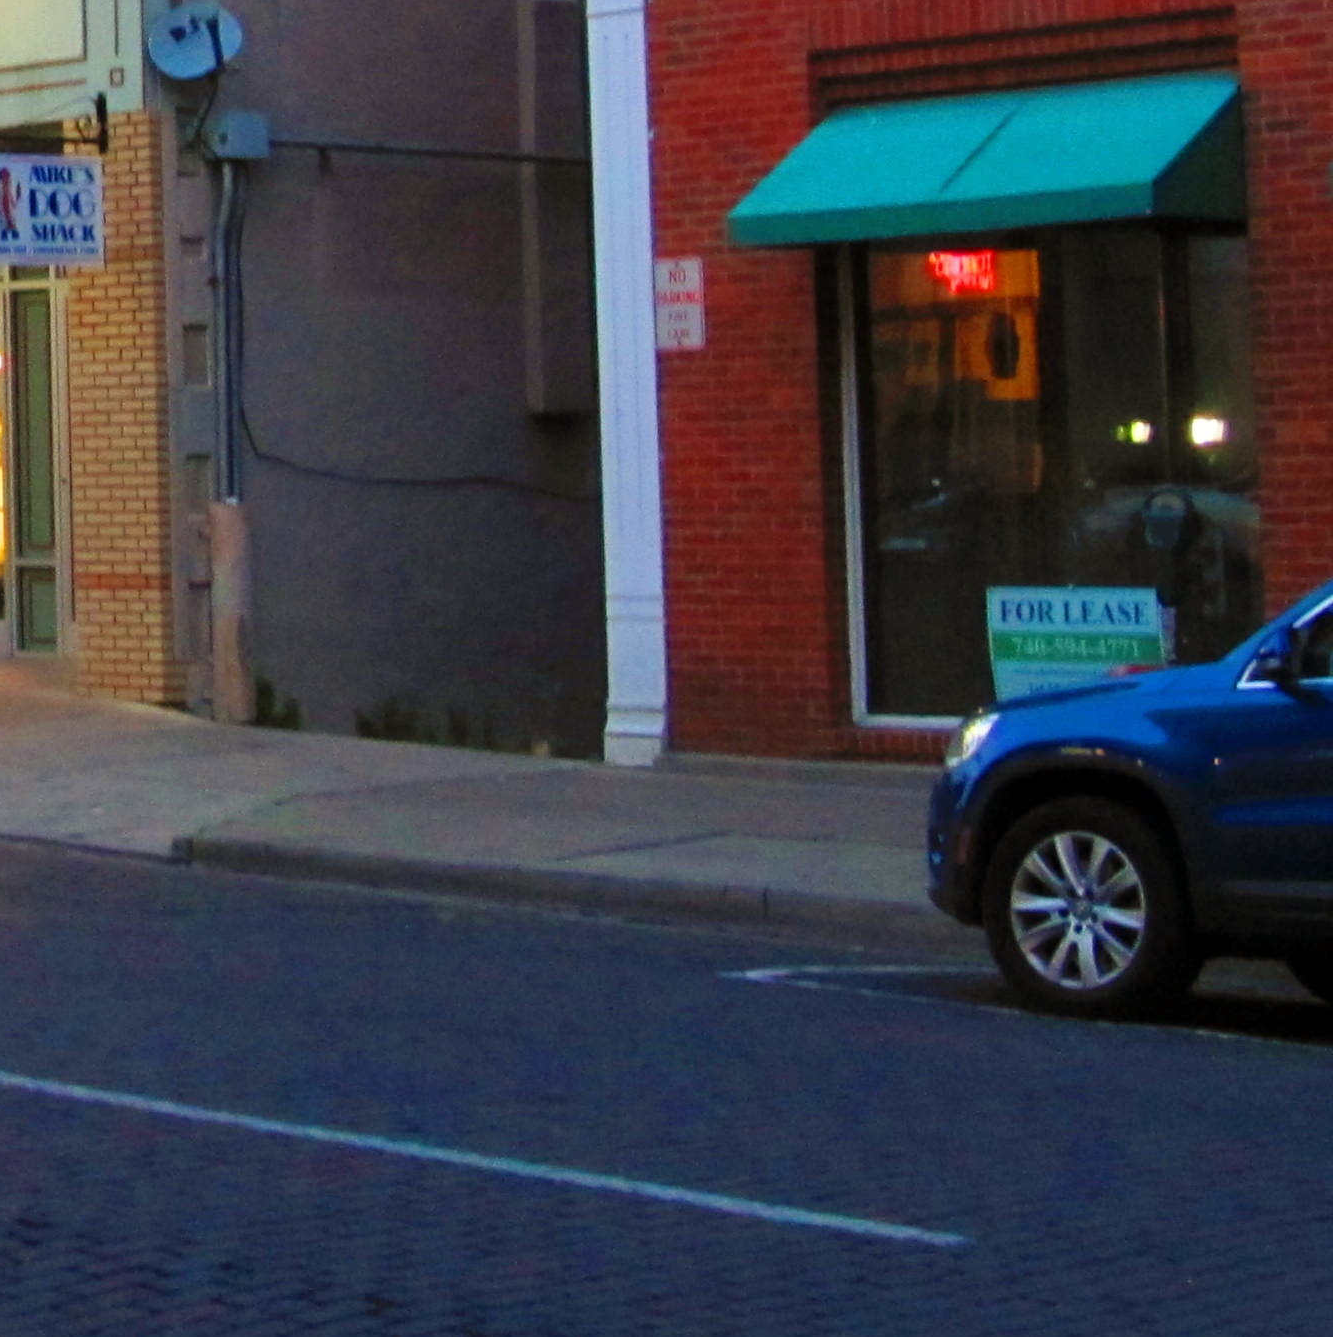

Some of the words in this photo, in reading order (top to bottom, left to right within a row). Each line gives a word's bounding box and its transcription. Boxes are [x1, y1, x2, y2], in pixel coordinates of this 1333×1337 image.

[29, 188, 96, 219] DOG
[31, 223, 96, 242] SHACK
[1000, 600, 1055, 625] FOR
[1063, 600, 1151, 626] LEASE
